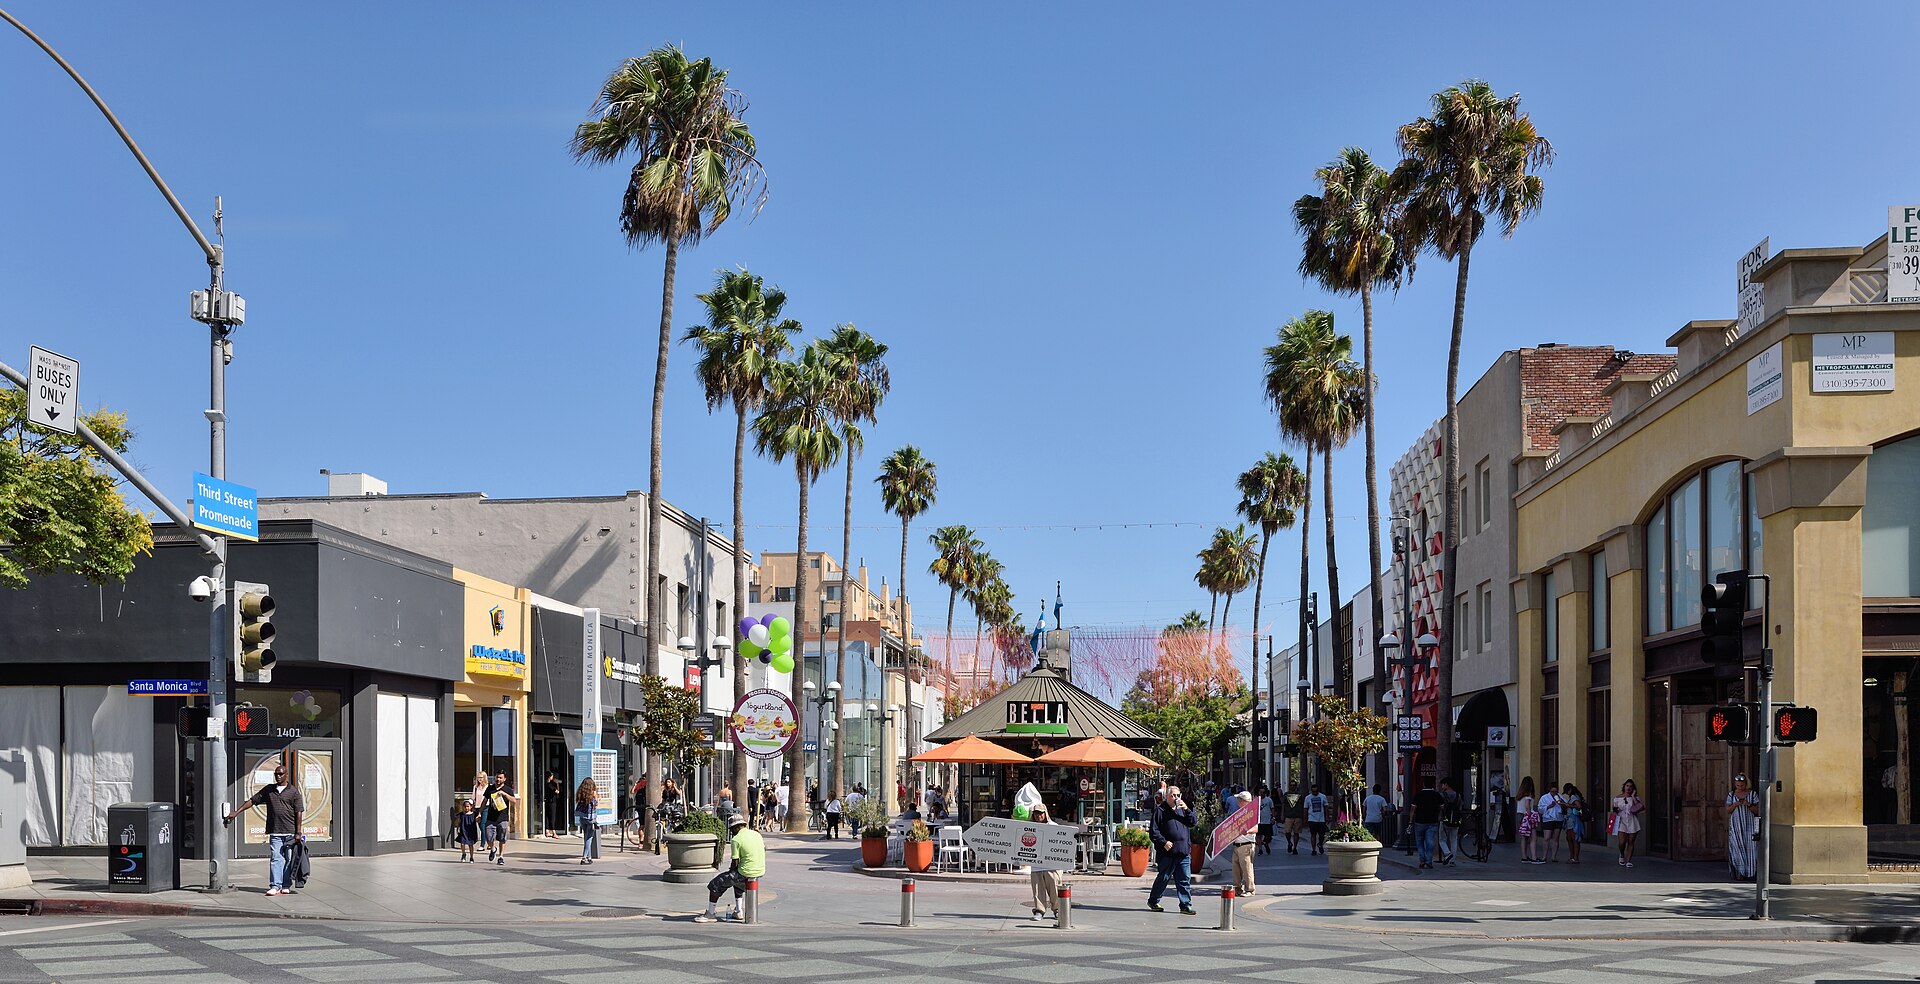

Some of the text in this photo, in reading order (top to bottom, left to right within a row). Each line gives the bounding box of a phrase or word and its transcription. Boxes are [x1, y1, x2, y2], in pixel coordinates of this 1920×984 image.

[1904, 208, 1920, 223] F
[1891, 226, 1920, 243] LE
[1742, 246, 1761, 272] FOR
[1738, 257, 1768, 293] LES
[1842, 335, 1866, 350] MP
[1758, 352, 1770, 369] MP
[37, 364, 71, 388] BUSES
[40, 385, 67, 405] ONLY
[197, 482, 253, 510] Third Street
[199, 504, 252, 530] Promenade
[130, 681, 188, 691] Santa Monica
[748, 689, 787, 700] FROZEN YOGURT
[746, 701, 784, 713] Yogurtland
[1009, 703, 1064, 724] BELLA
[276, 727, 301, 738] 1401
[971, 837, 995, 845] GREETING
[977, 846, 1007, 855] SOUVENIERS
